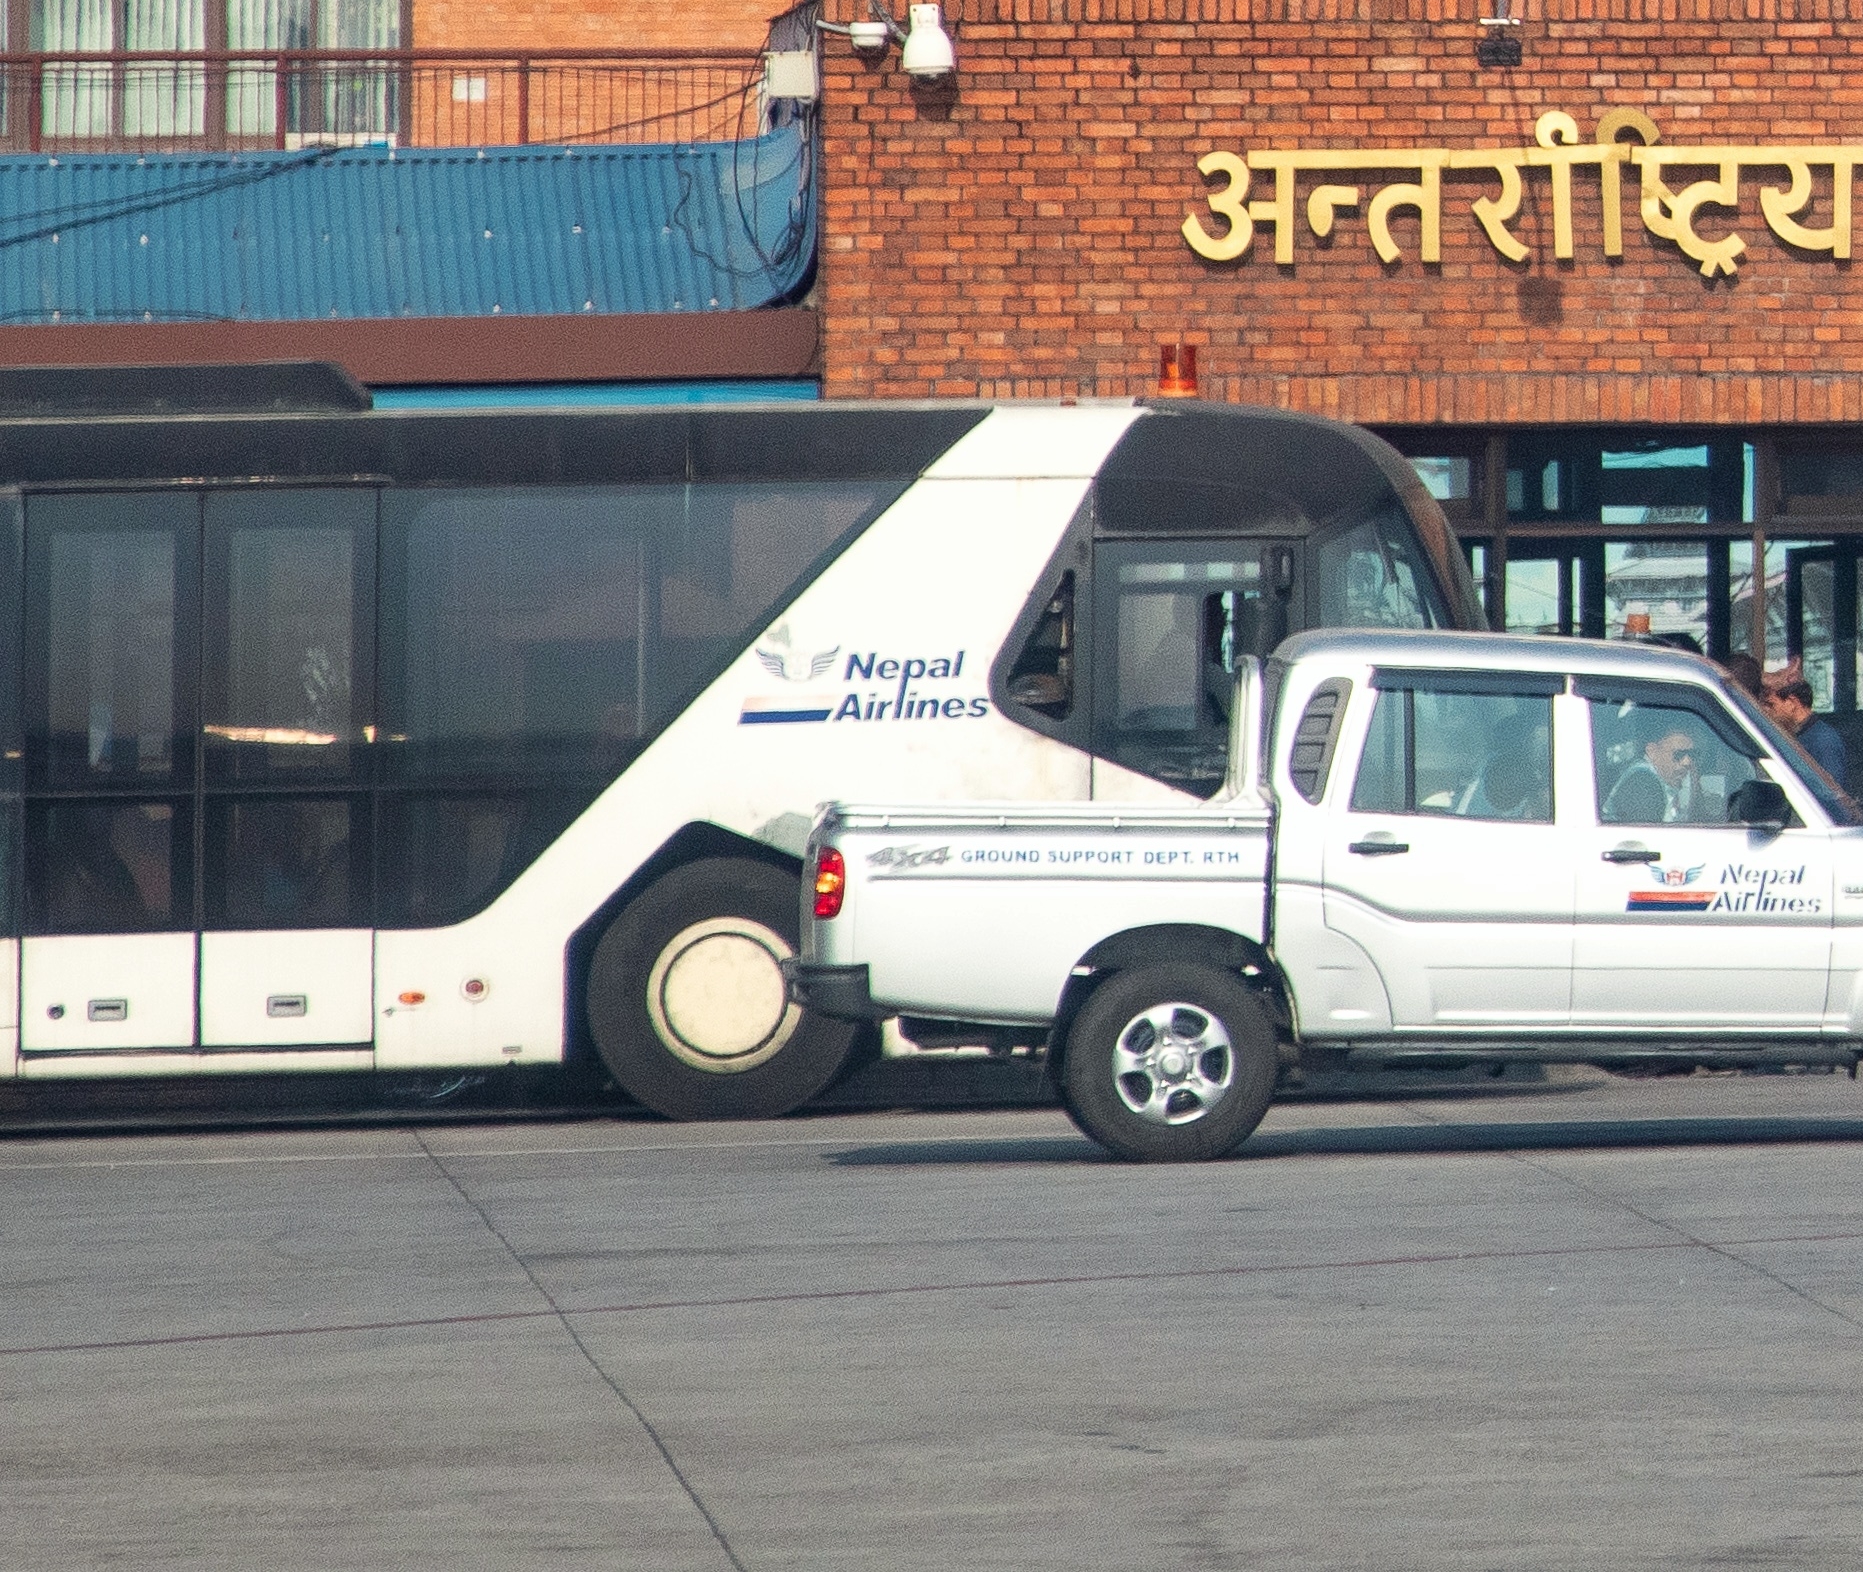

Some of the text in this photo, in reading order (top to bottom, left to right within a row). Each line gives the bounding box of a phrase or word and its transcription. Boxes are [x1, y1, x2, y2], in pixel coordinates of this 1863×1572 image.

[842, 650, 966, 691] Nepal
[833, 690, 989, 722] Airlines
[960, 849, 1040, 864] GROUND
[1048, 849, 1134, 864] SUPPORT
[1143, 850, 1194, 865] DEPT.
[1203, 851, 1240, 865] RTH
[1719, 864, 1806, 891] Nepal
[1711, 888, 1822, 914] Airlines
